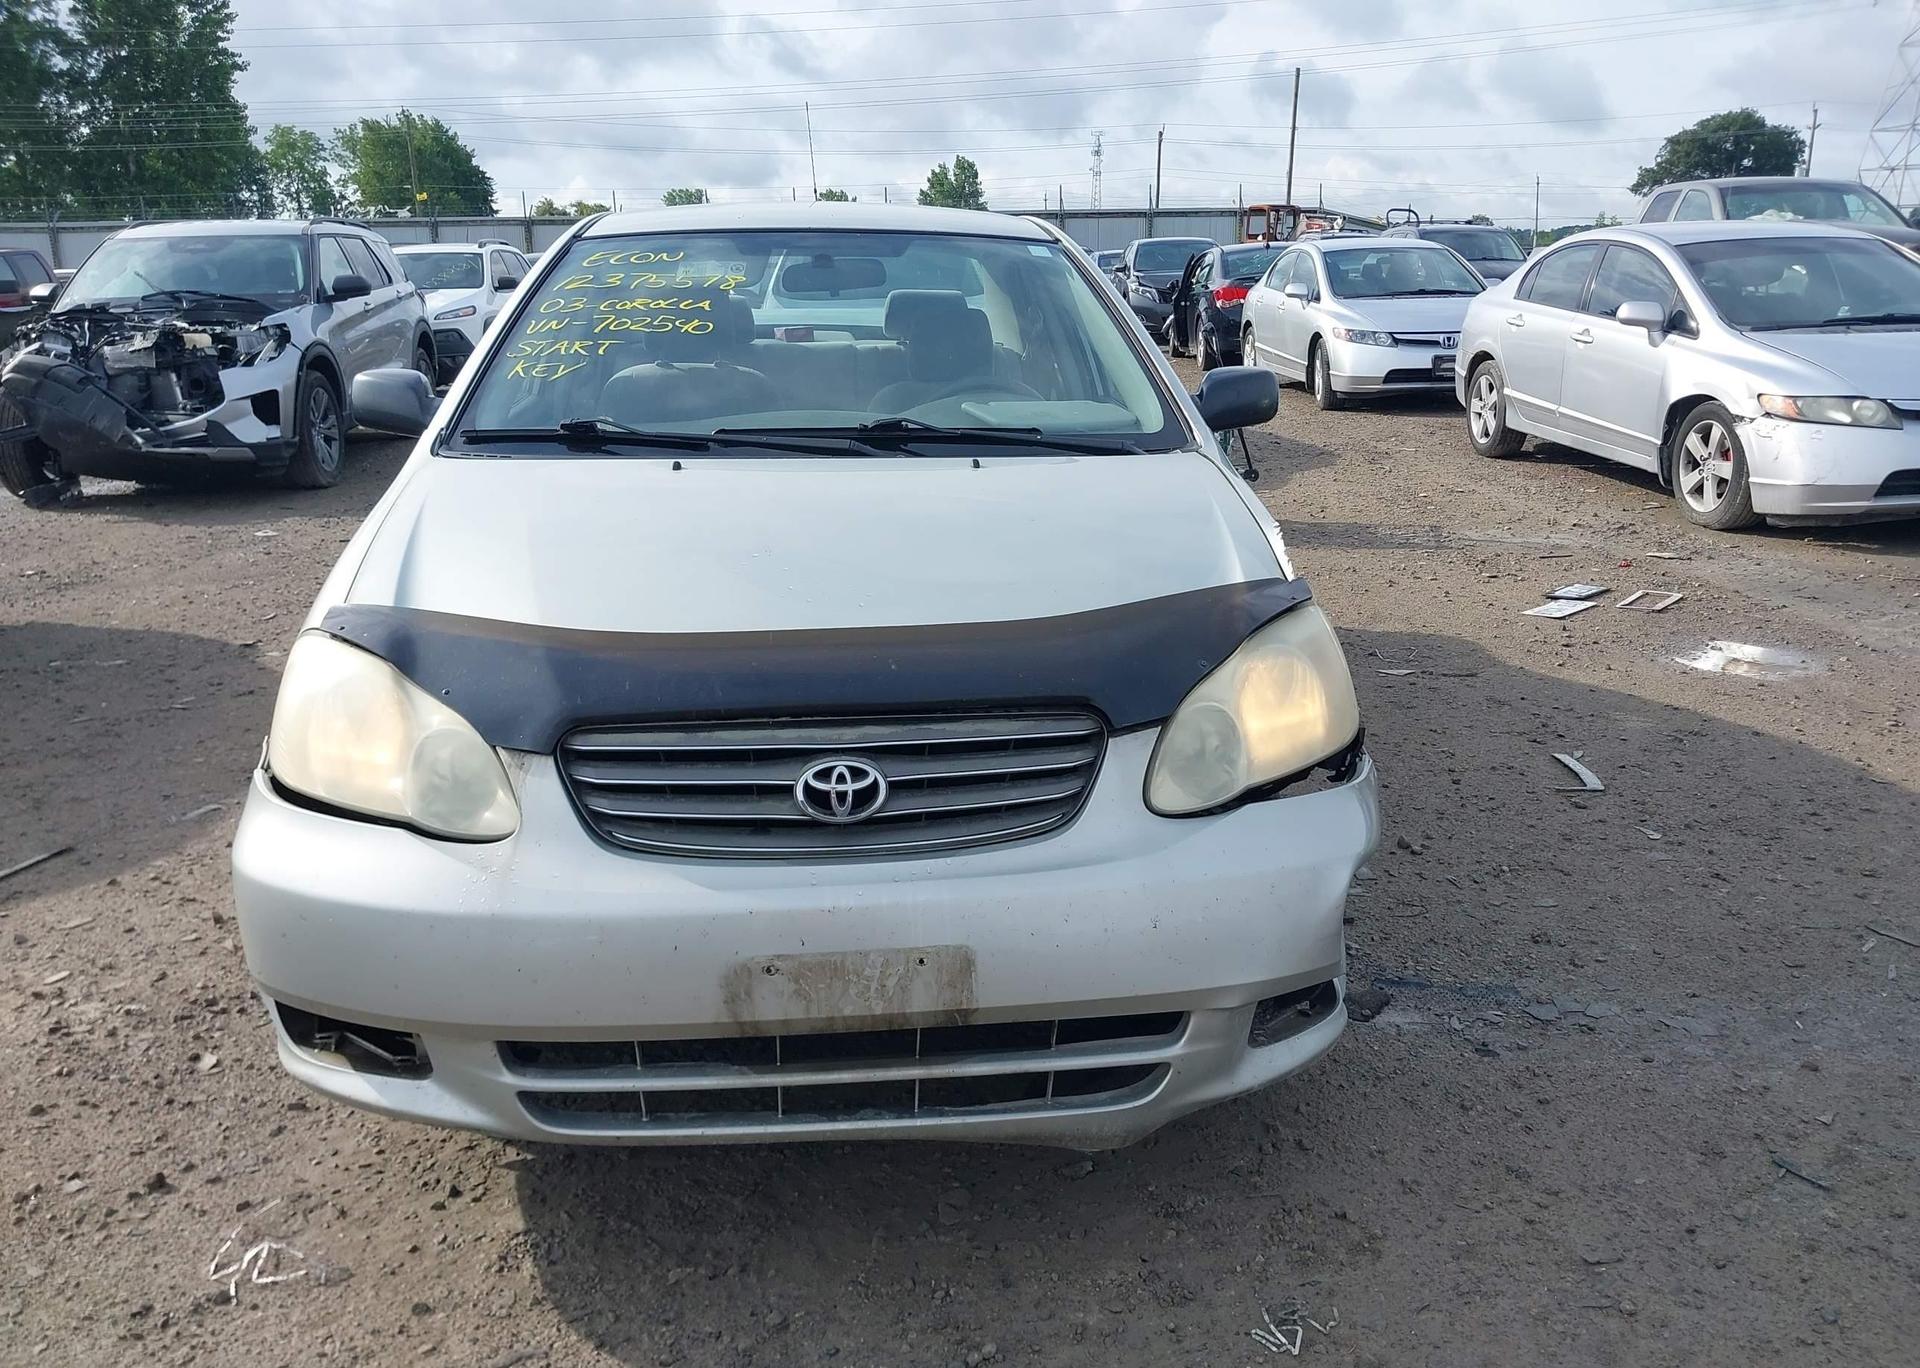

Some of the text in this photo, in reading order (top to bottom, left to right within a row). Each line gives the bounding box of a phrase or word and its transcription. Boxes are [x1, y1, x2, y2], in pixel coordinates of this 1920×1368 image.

[582, 250, 685, 268] ECON
[553, 272, 747, 292] 12375578
[507, 340, 625, 358] START
[507, 359, 587, 381] KEY
